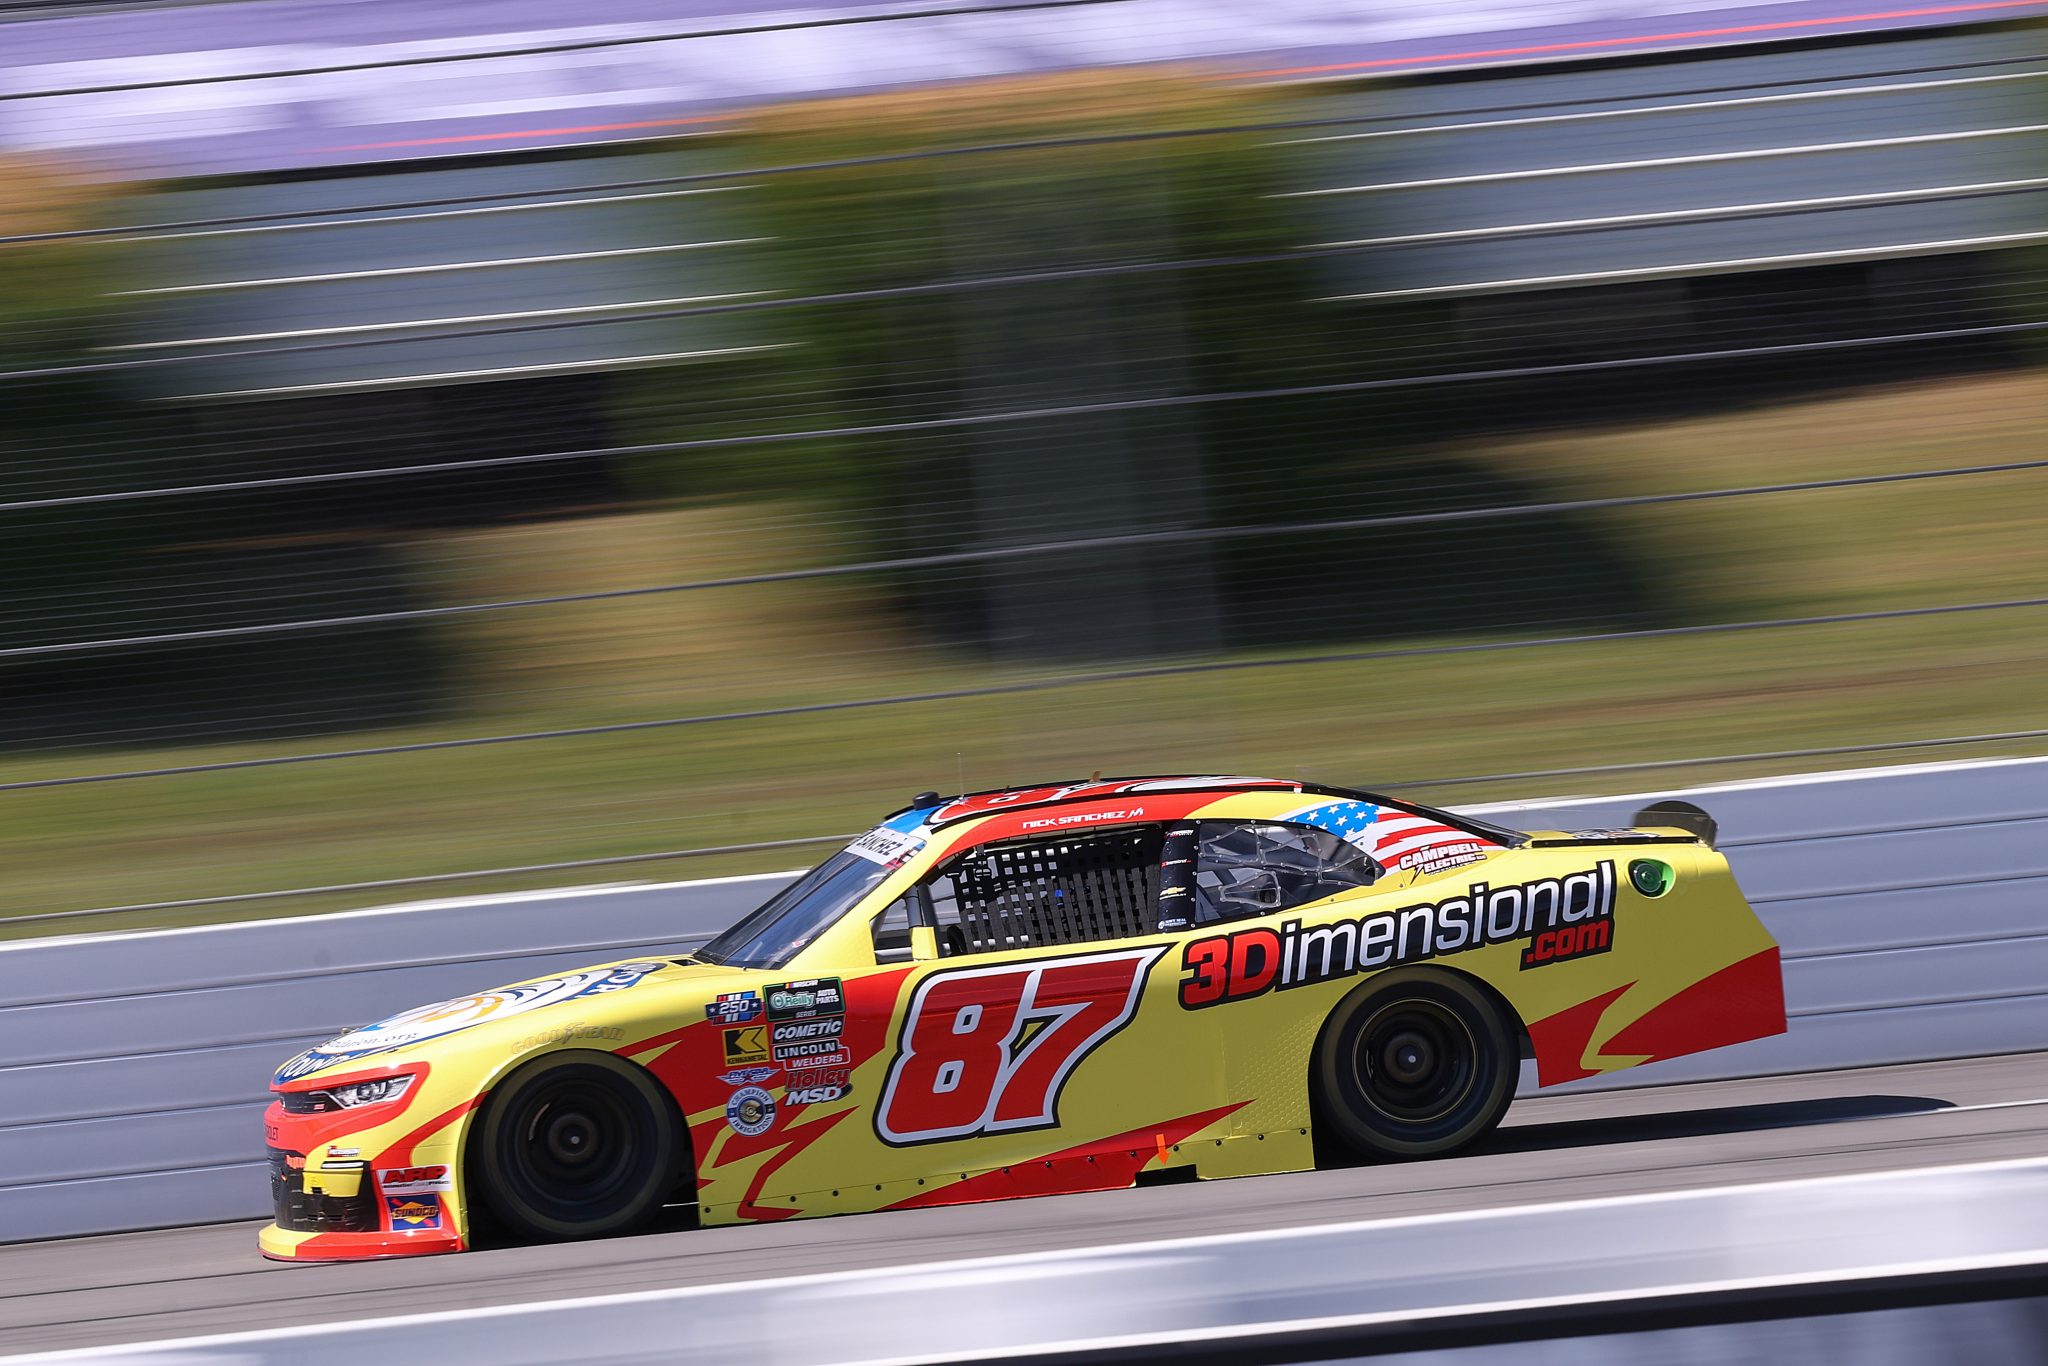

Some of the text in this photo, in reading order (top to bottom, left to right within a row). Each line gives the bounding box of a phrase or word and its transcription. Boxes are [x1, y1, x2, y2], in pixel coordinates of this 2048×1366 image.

[1022, 810, 1126, 829] NICK SANCHEZ
[1400, 843, 1482, 869] CAMPBELL
[1424, 853, 1476, 872] ELECTRIC
[1183, 861, 1613, 1005] 3Dimensional
[1526, 920, 1609, 964] .com
[816, 995, 839, 1004] PARTS
[817, 988, 836, 997] AUTO
[719, 1000, 749, 1015] 250
[796, 1010, 817, 1018] SERIES
[774, 1019, 842, 1040] COMETIC
[777, 1041, 836, 1058] LINCOLN
[876, 944, 1176, 1144] 87
[792, 1054, 843, 1068] WELDERS
[786, 1069, 850, 1090] Holley
[731, 1088, 769, 1106] CHAMPION
[785, 1086, 842, 1106] MSD
[732, 1115, 773, 1134] IRRIGATION
[383, 1165, 447, 1184] ARP
[394, 1206, 436, 1217] SUNOCO
